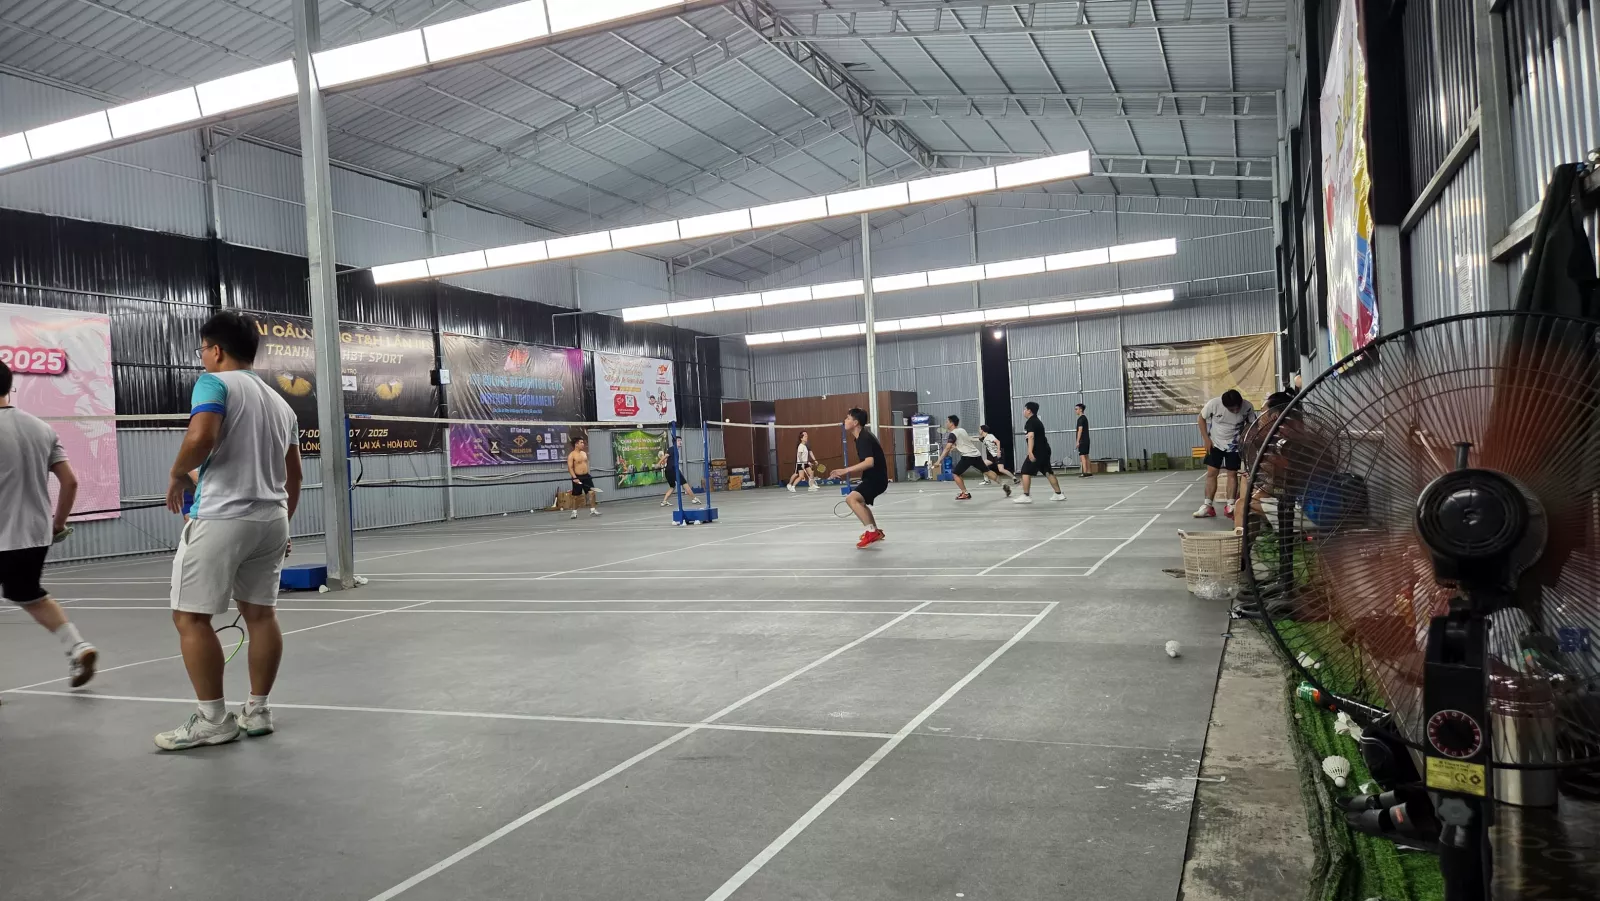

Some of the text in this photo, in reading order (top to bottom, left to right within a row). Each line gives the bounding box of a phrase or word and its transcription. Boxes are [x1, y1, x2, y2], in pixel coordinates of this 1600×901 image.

[266, 344, 310, 357] TRANH
[0, 349, 62, 371] 2025
[368, 352, 403, 364] SPORT
[1180, 355, 1196, 365] LÔNG
[515, 394, 554, 406] TOURNAMENT
[368, 429, 389, 438] 2025
[359, 441, 370, 449] LAI
[387, 439, 402, 448] HOÀI
